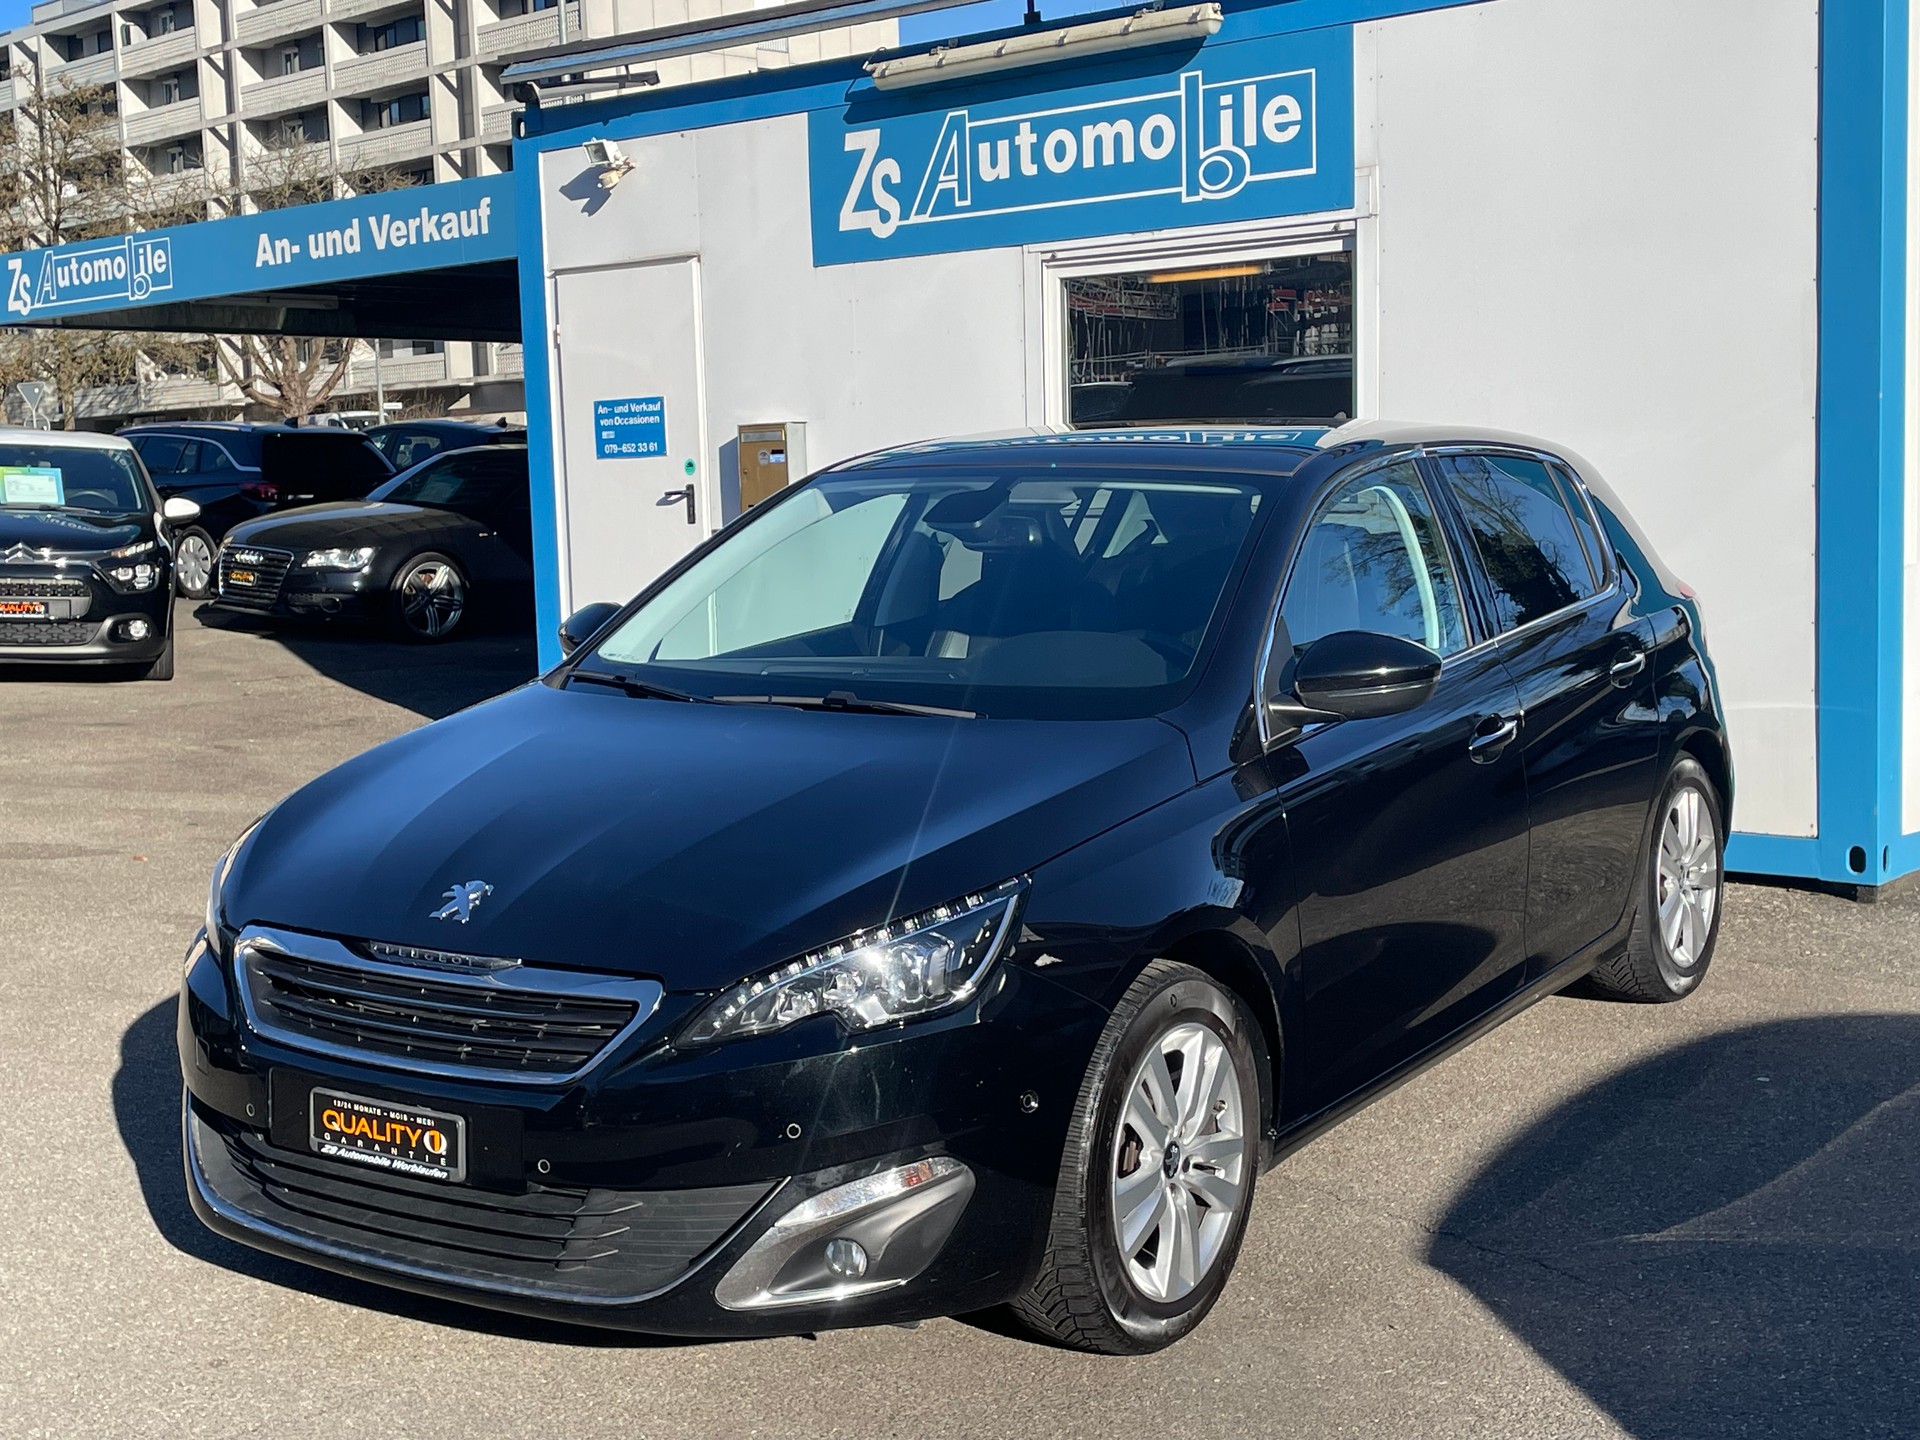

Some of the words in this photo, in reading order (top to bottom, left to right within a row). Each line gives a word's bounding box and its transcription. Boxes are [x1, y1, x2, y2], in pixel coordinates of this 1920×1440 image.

[910, 70, 1302, 219] Automobile
[255, 233, 300, 268] An-
[308, 218, 361, 260] und
[368, 196, 492, 251] Verkauf
[34, 236, 168, 306] Automobile
[598, 404, 613, 415] An-
[614, 403, 629, 414] und
[629, 401, 661, 413] Verkauf
[600, 418, 614, 426] von
[614, 414, 660, 426] Occasionen
[604, 443, 637, 454] 079-652
[637, 442, 648, 452] 33
[649, 442, 658, 452] 61
[353, 1103, 382, 1116] MONATE
[322, 1109, 422, 1148] QUALITY
[324, 1132, 447, 1166] GARANTIE
[337, 1147, 392, 1167] Automobile
[391, 1159, 448, 1179] Worblaufen
